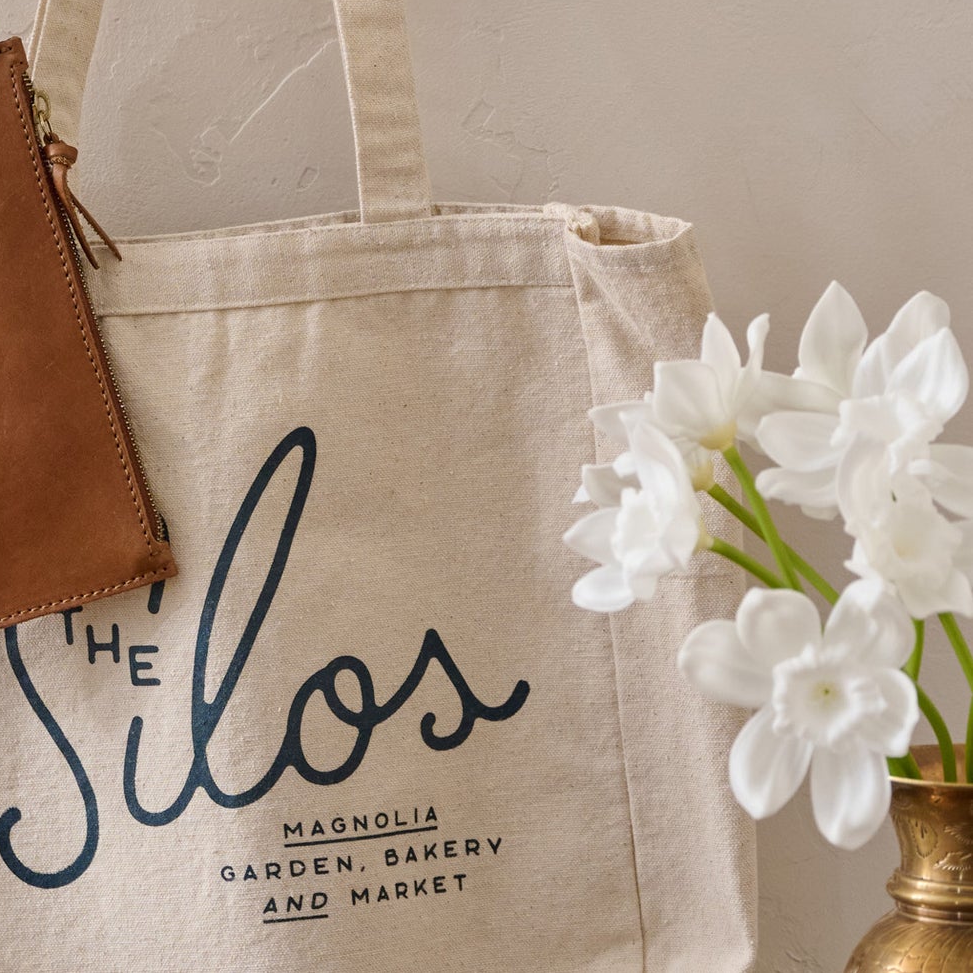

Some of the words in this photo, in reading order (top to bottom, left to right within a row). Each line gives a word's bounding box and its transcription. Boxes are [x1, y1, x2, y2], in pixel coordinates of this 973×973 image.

[60, 606, 161, 686] THE
[283, 806, 438, 840] MAGNOLIA
[220, 855, 366, 883] GARDEN,
[384, 837, 502, 867] BAKERY
[263, 891, 329, 914] AND
[351, 874, 467, 906] MARKET
